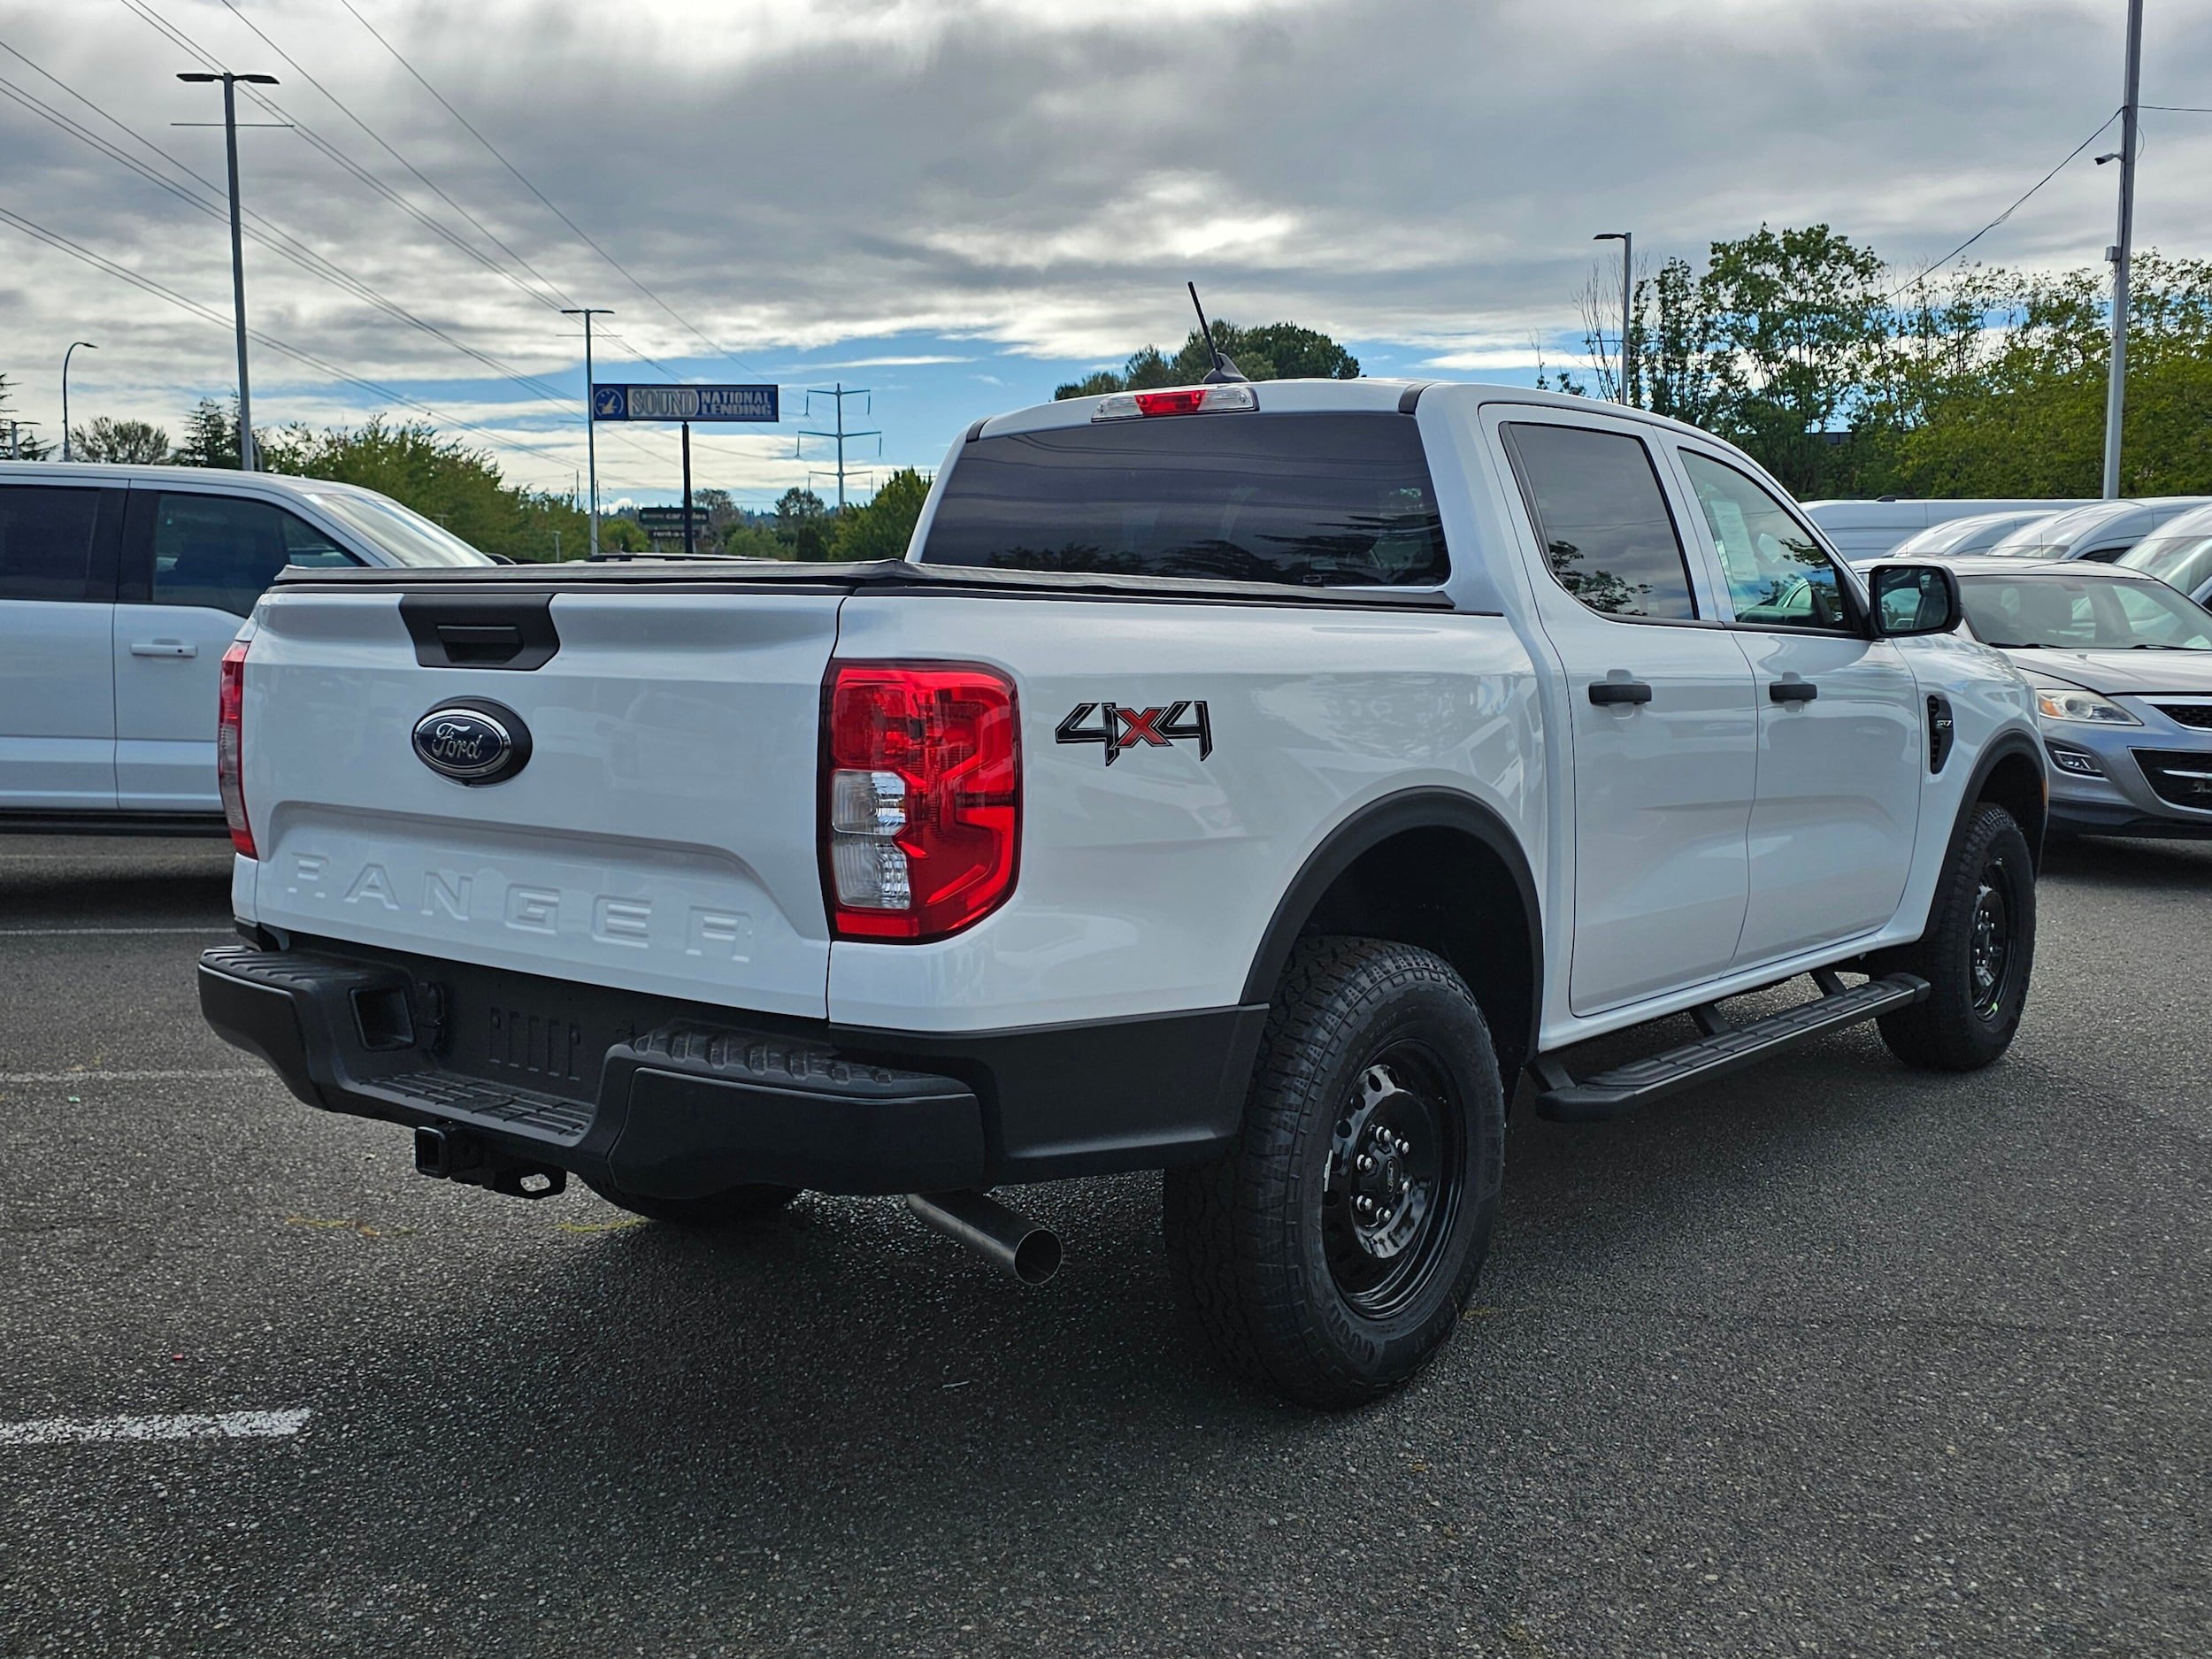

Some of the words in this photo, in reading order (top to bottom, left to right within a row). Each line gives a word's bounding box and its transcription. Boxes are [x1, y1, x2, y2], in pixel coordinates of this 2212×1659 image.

[632, 389, 697, 417] SOUND
[701, 391, 769, 404] NATIONAL
[702, 404, 772, 416] LENDING
[432, 722, 482, 759] Ford
[286, 851, 753, 963] RANGER
